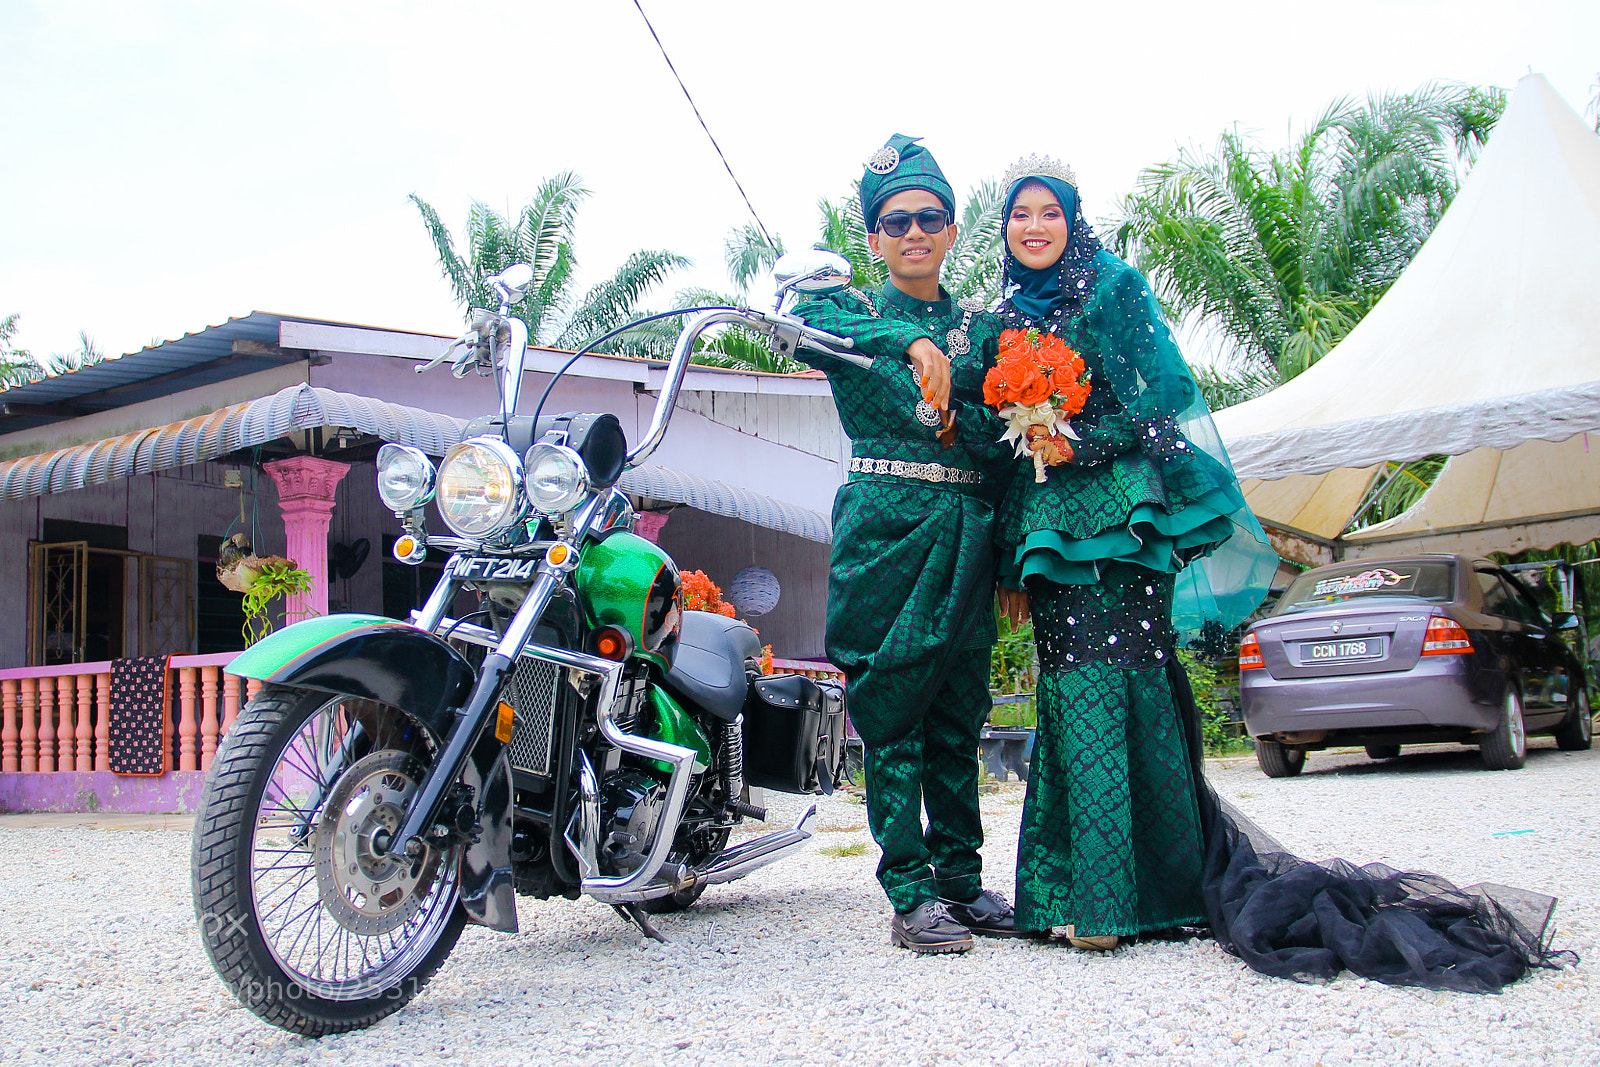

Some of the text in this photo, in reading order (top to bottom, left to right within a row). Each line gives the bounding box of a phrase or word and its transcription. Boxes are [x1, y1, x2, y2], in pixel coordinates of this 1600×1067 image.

[453, 557, 536, 579] WFT2114
[1313, 642, 1367, 658] CCN 1768
